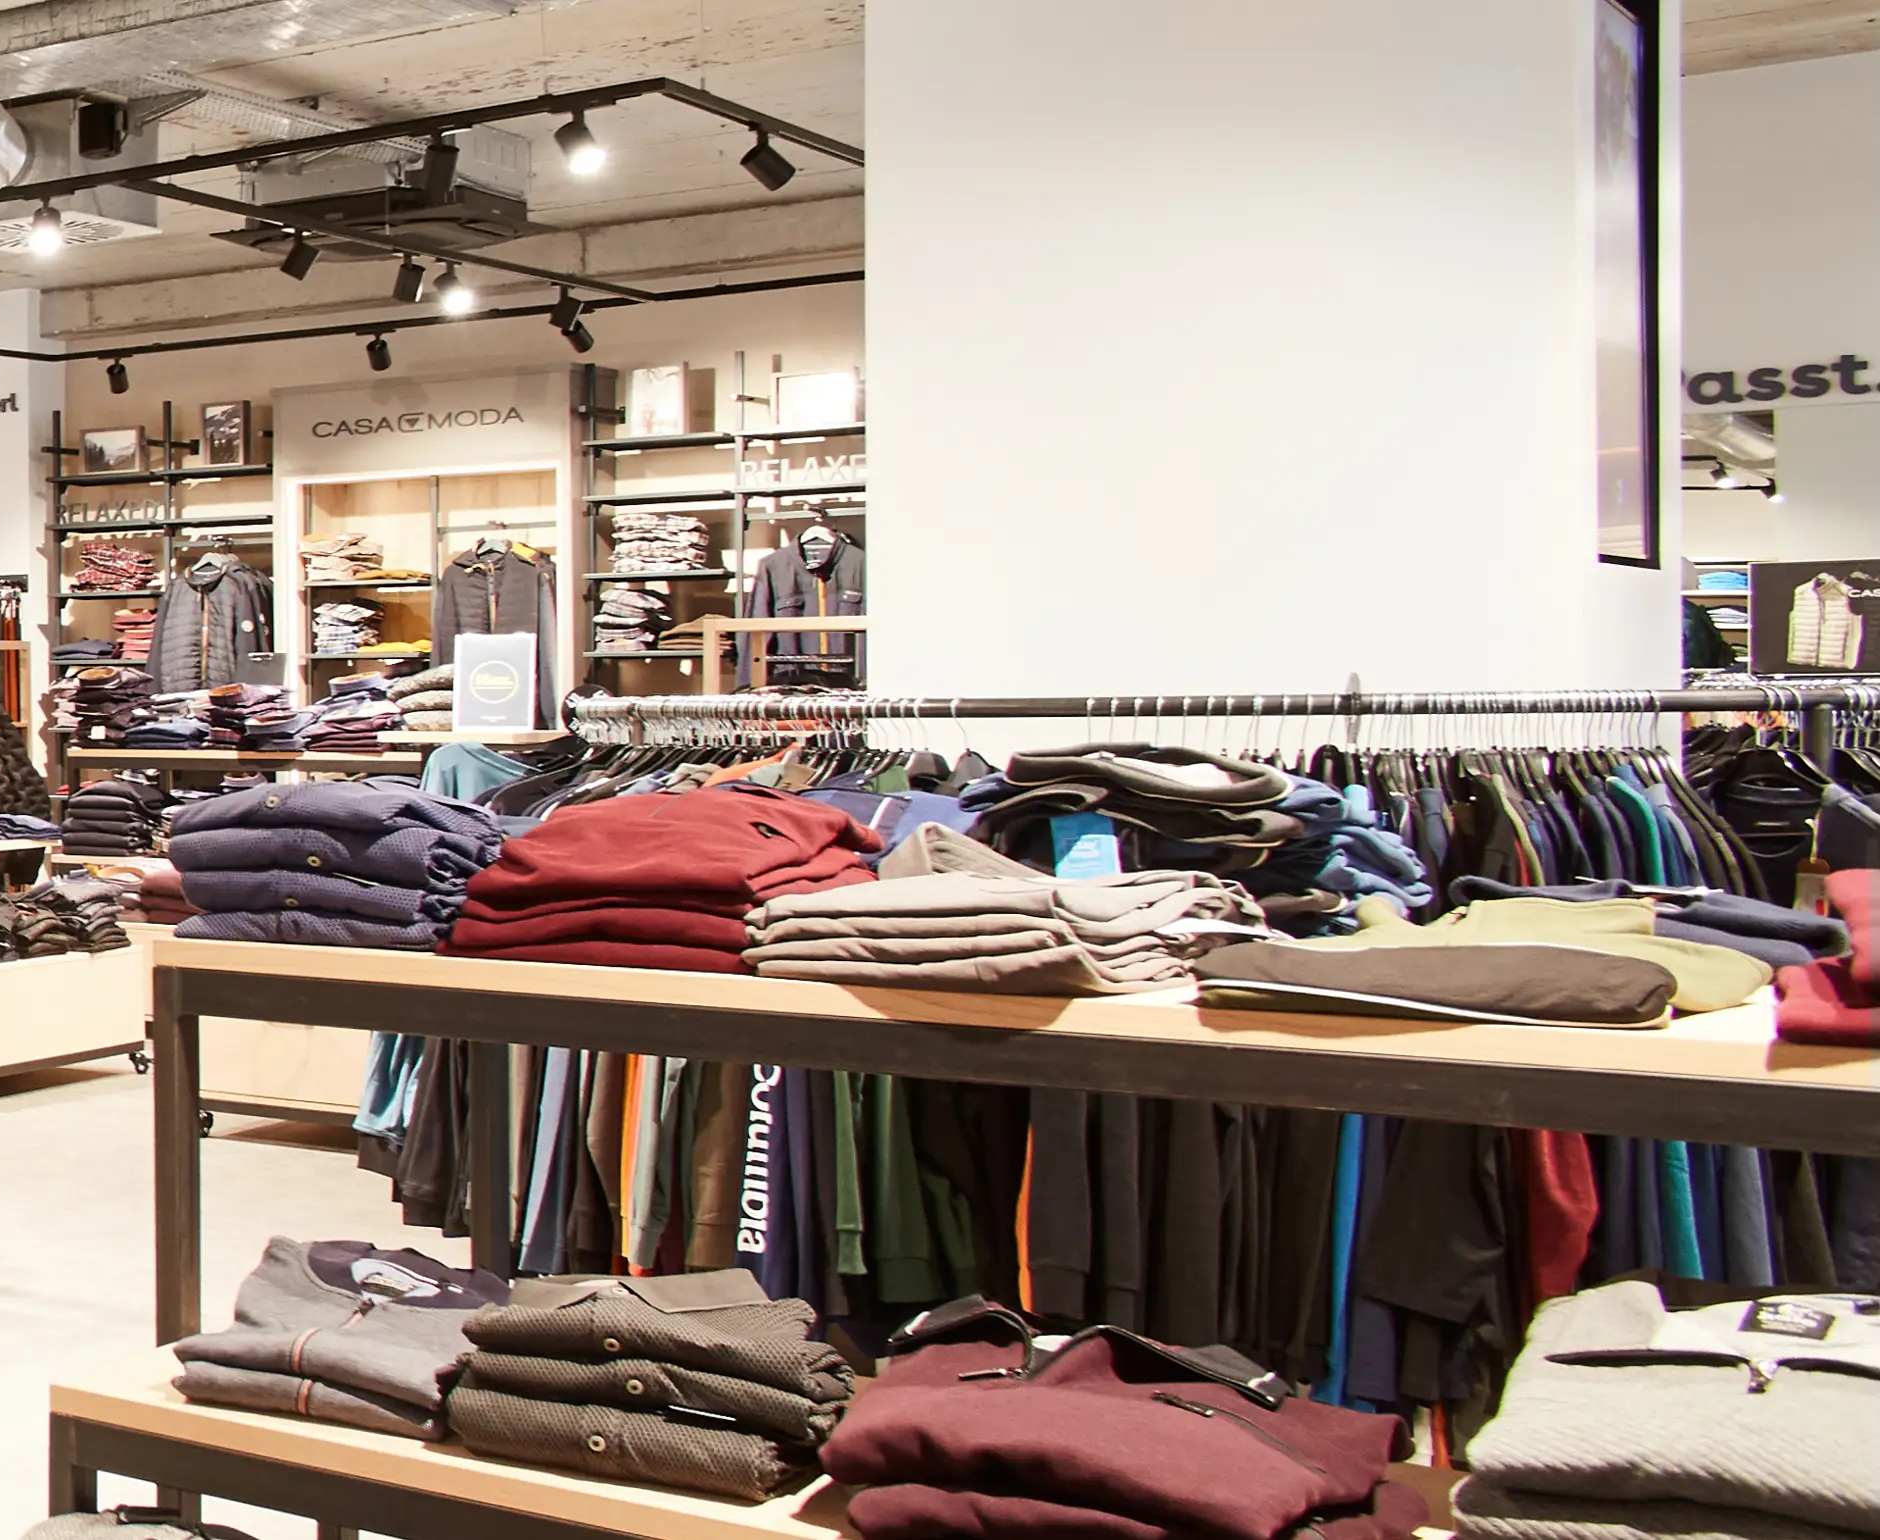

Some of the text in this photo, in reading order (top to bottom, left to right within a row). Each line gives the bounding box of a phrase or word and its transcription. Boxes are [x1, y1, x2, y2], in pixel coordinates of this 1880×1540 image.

[1681, 354, 1880, 405] asst
[311, 406, 524, 438] CASA MODA
